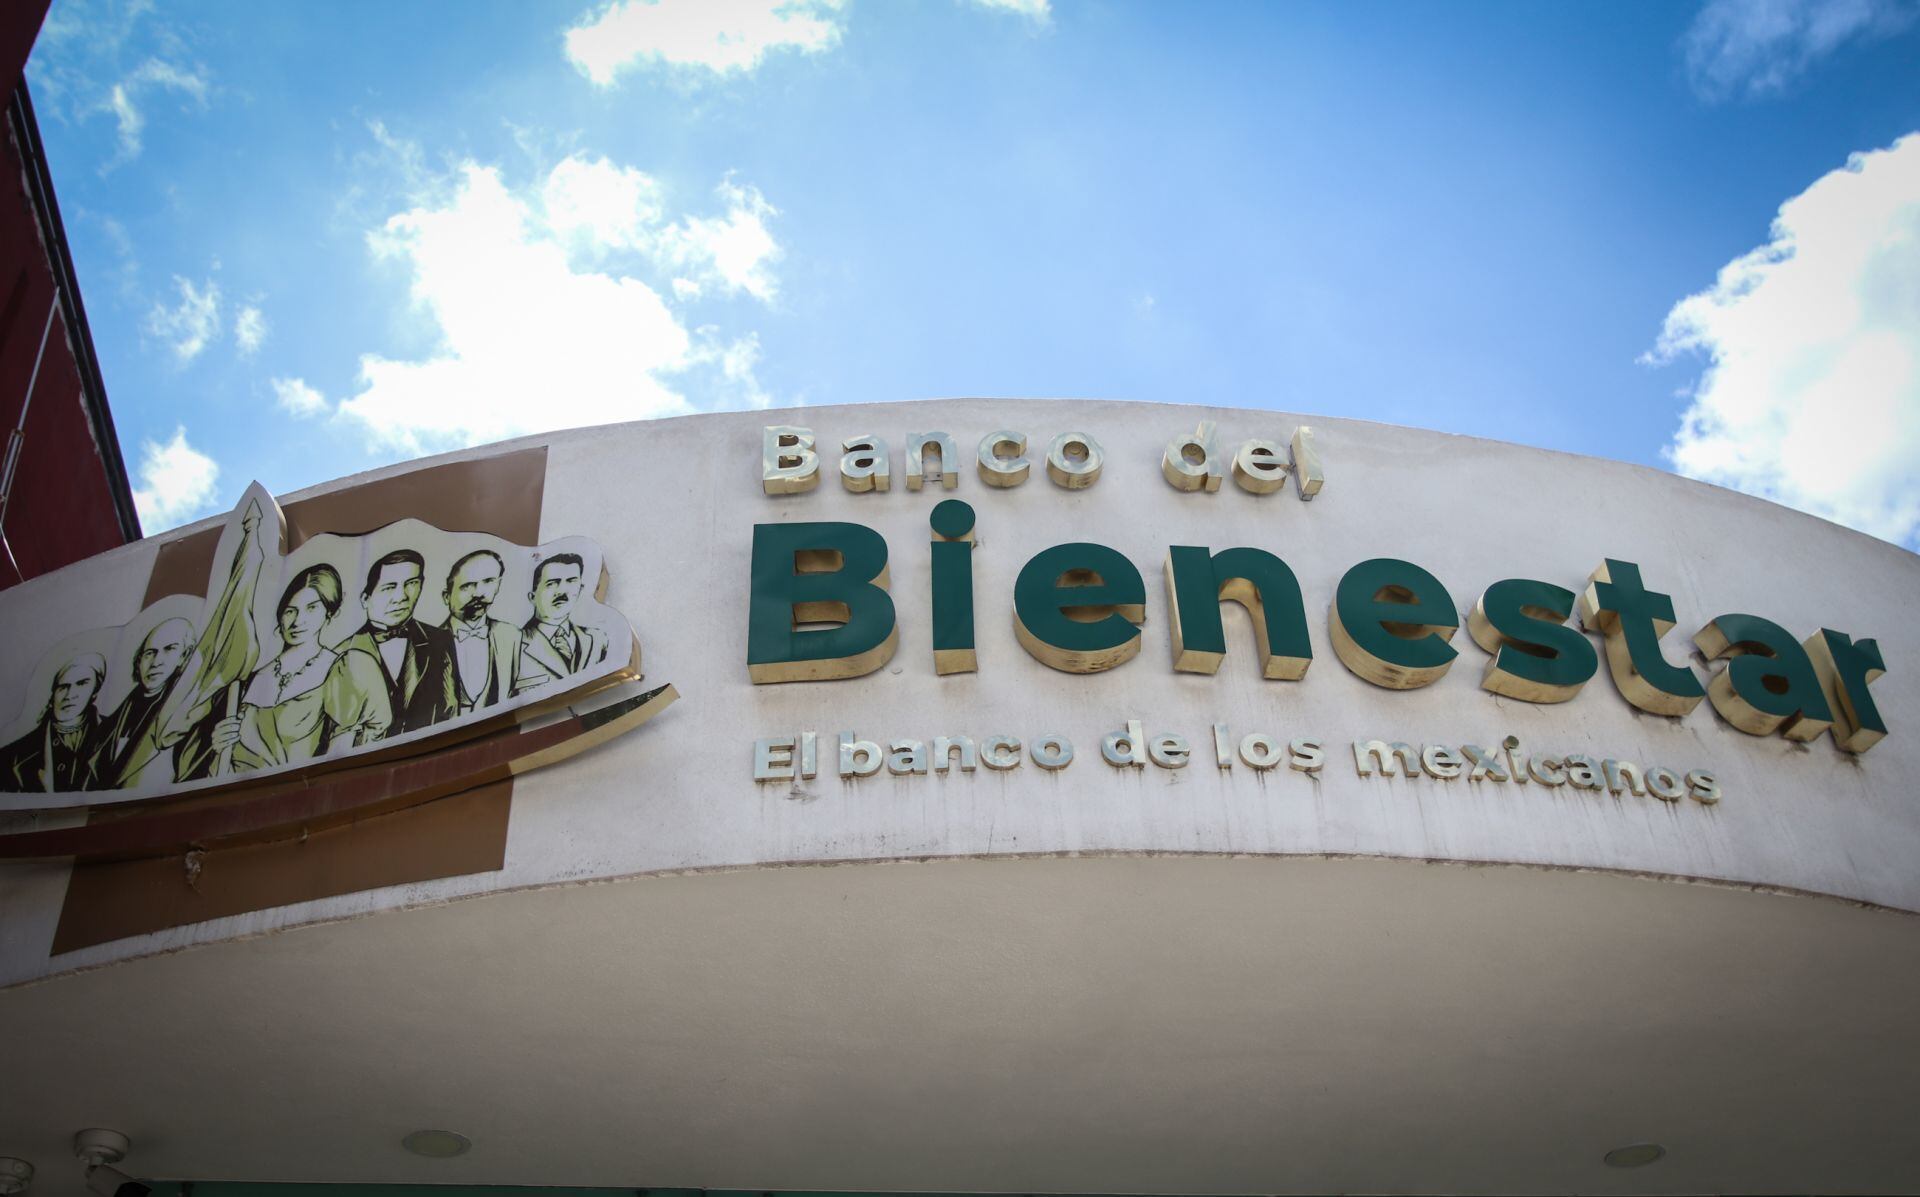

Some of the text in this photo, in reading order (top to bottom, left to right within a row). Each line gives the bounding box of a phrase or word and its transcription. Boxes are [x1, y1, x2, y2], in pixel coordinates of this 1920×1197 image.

[763, 420, 1324, 500] Banco del
[747, 499, 1888, 753] Bienestar
[754, 719, 1722, 804] El banco de los mexicanos
